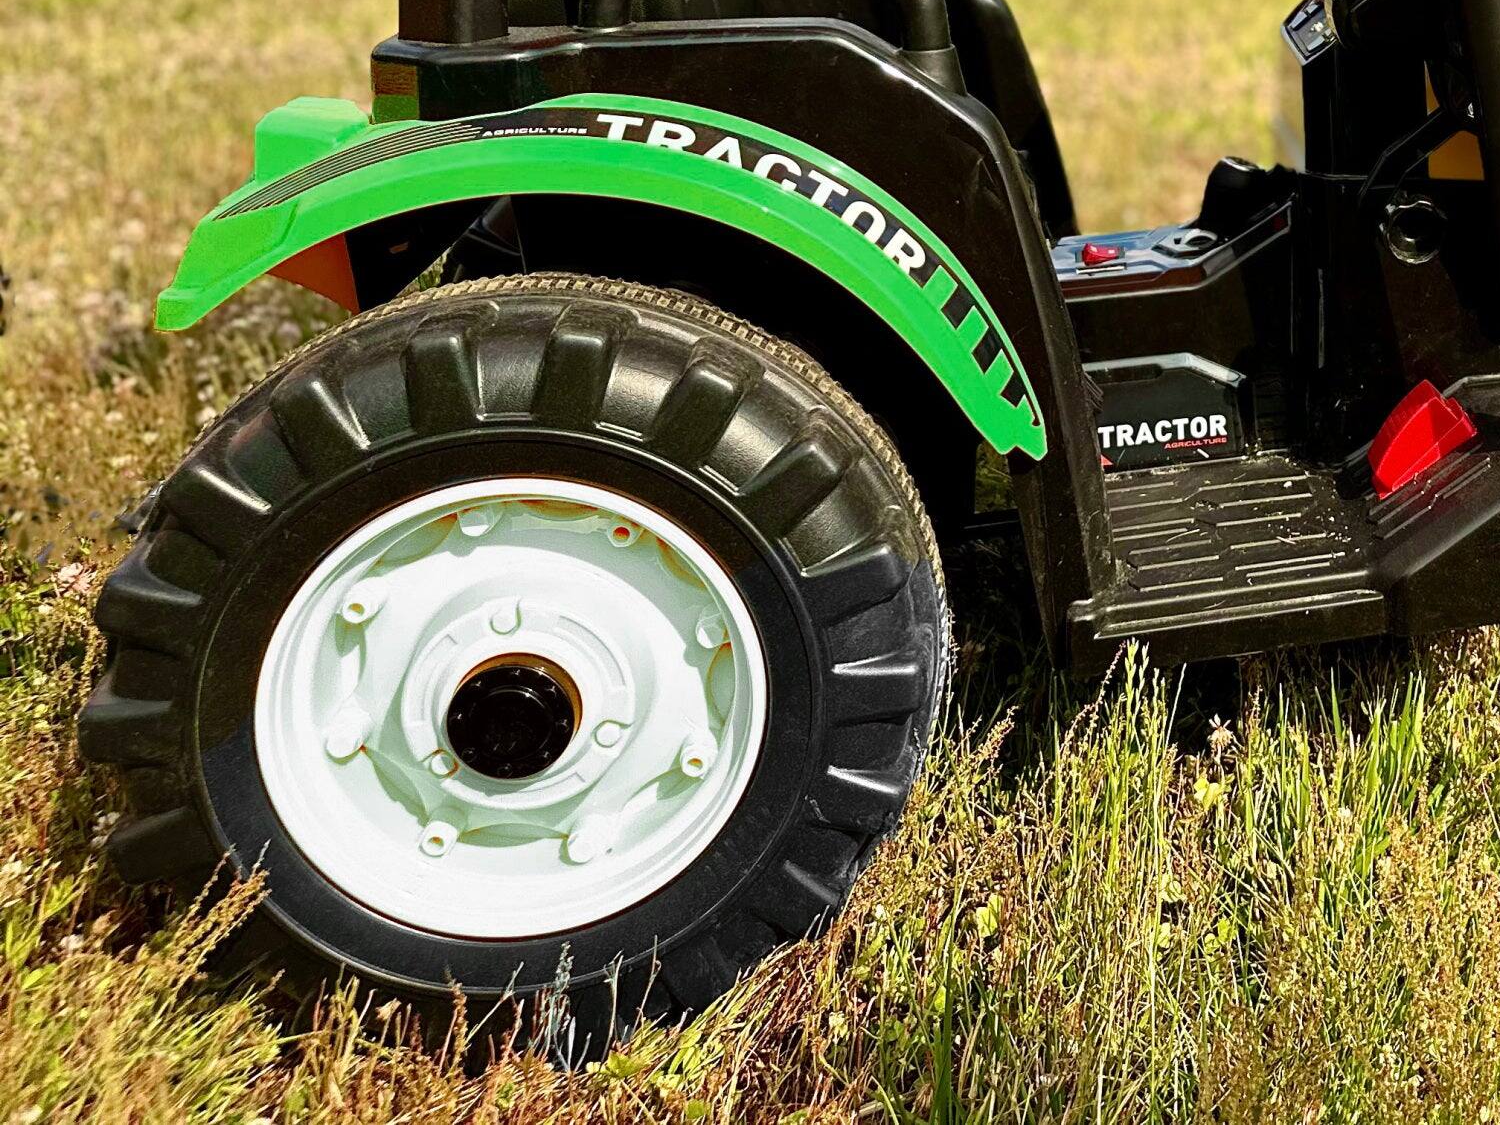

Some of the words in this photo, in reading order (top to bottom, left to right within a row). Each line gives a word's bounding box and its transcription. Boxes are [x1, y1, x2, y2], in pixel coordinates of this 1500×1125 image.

[481, 127, 588, 137] AGRICULTURE
[596, 114, 927, 276] TRACTOR
[1097, 414, 1228, 449] TRACTOR
[1164, 437, 1227, 450] AGRICULTURE
